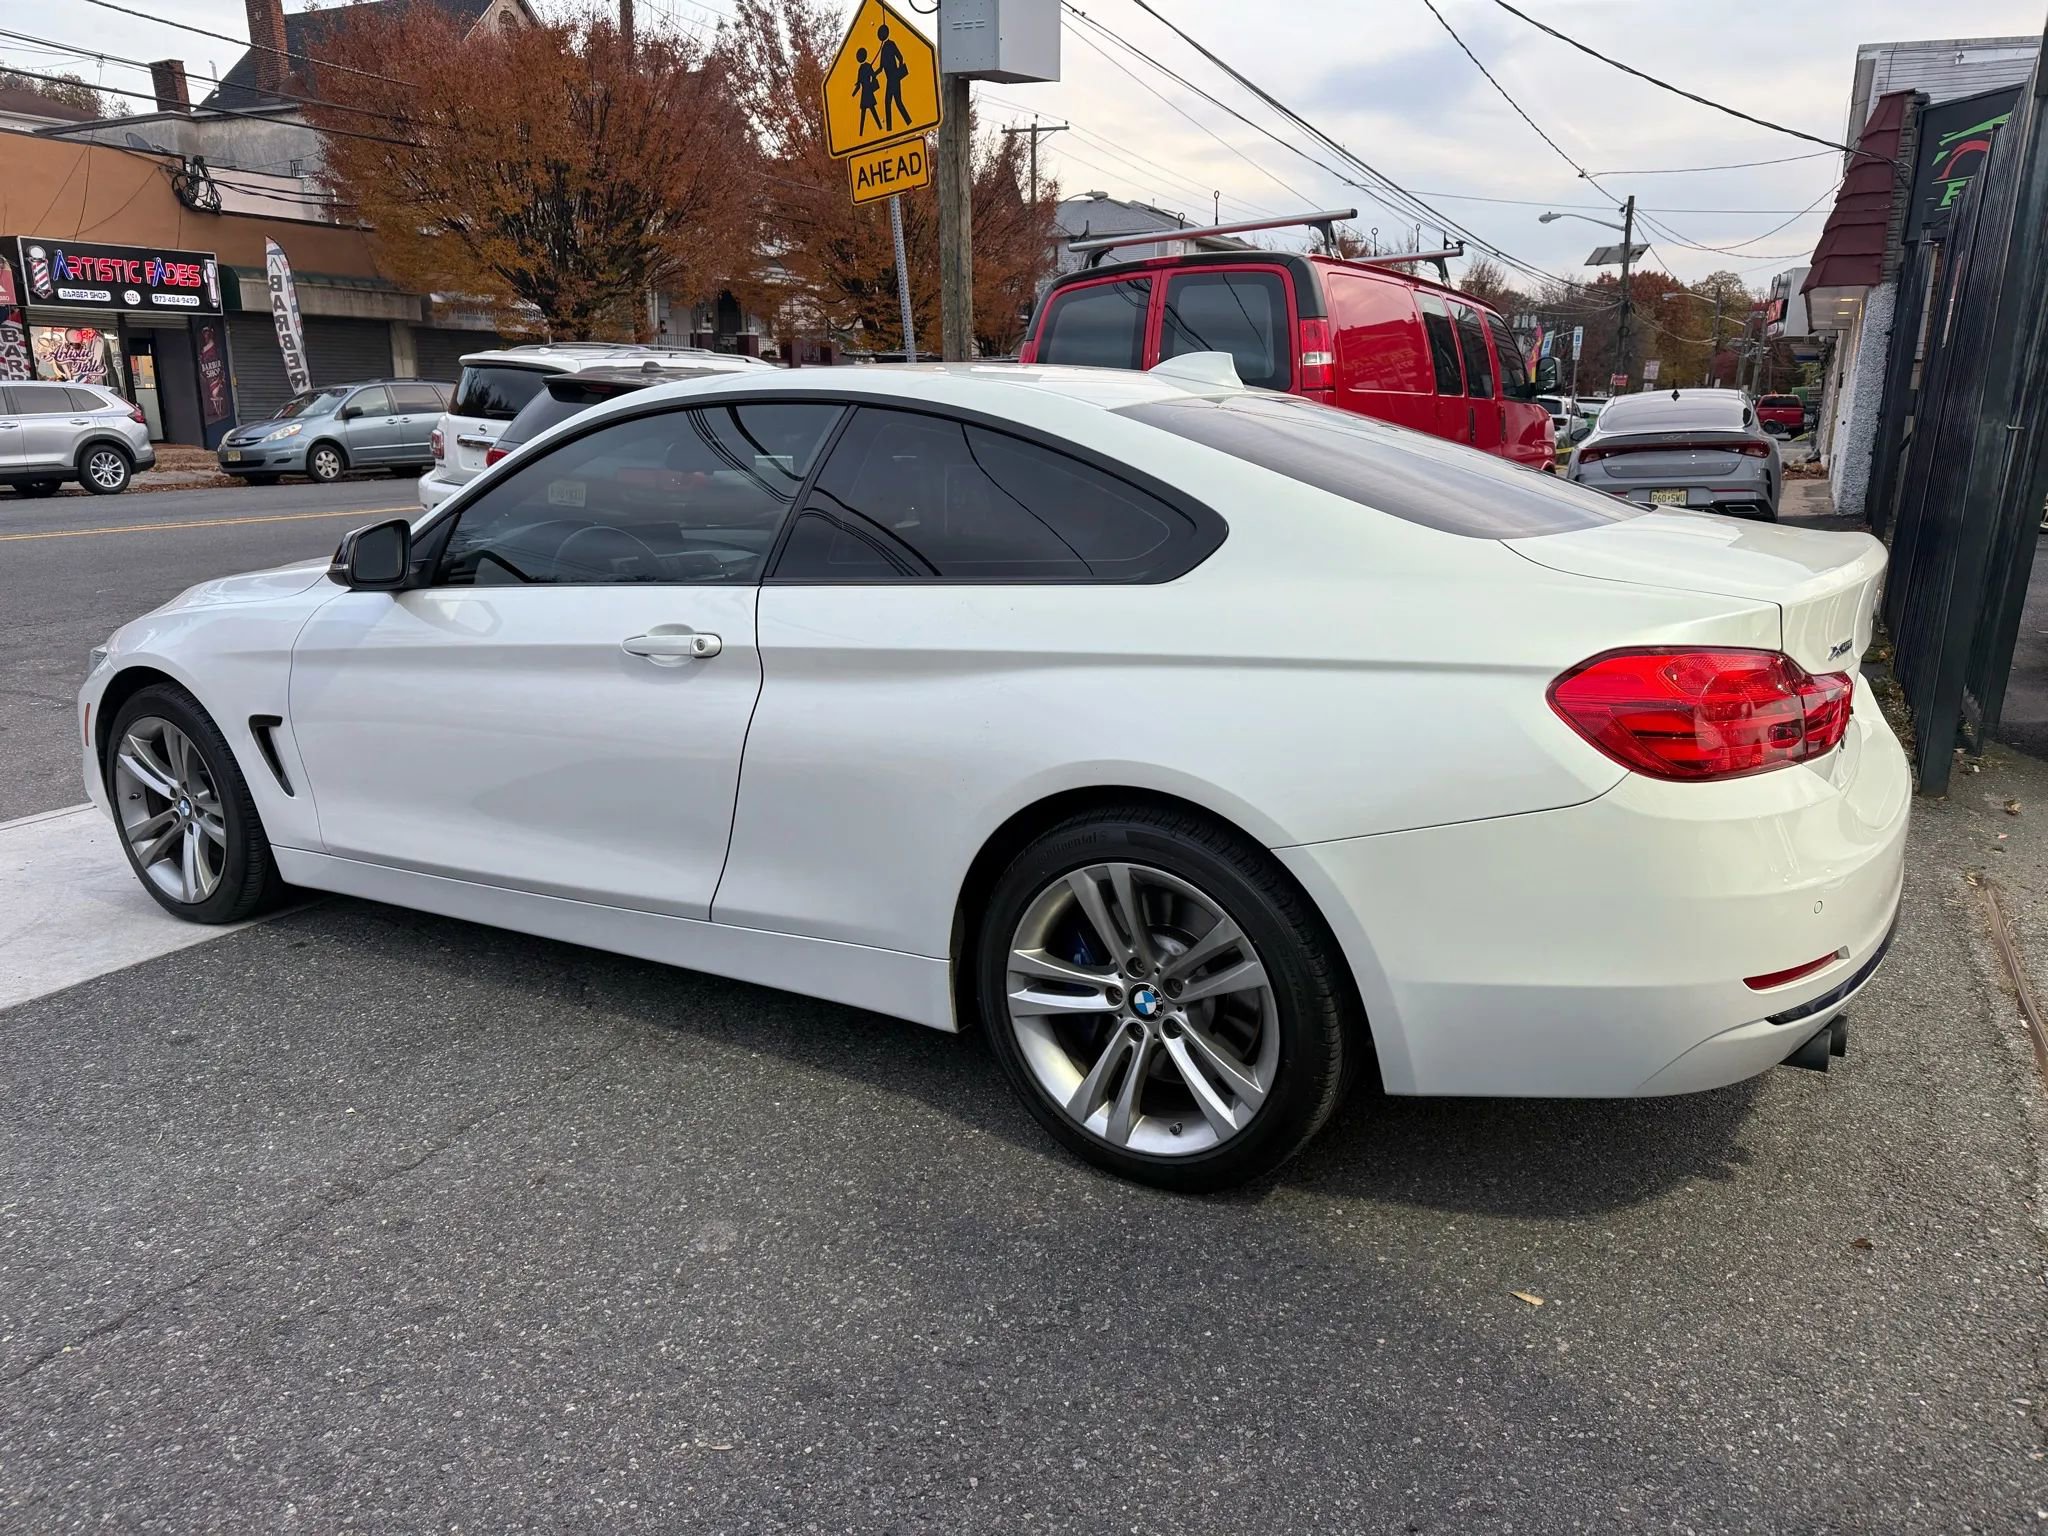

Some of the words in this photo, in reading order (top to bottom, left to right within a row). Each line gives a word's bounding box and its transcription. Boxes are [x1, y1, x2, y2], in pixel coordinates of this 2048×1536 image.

[857, 150, 922, 190] AHEAD
[53, 249, 142, 284] ARTISTIC
[145, 257, 202, 288] FADES
[62, 290, 89, 299] BARBER
[89, 291, 107, 300] SHOP
[44, 342, 94, 363] Artistic
[201, 360, 222, 372] BARBER
[206, 367, 221, 378] SHOP
